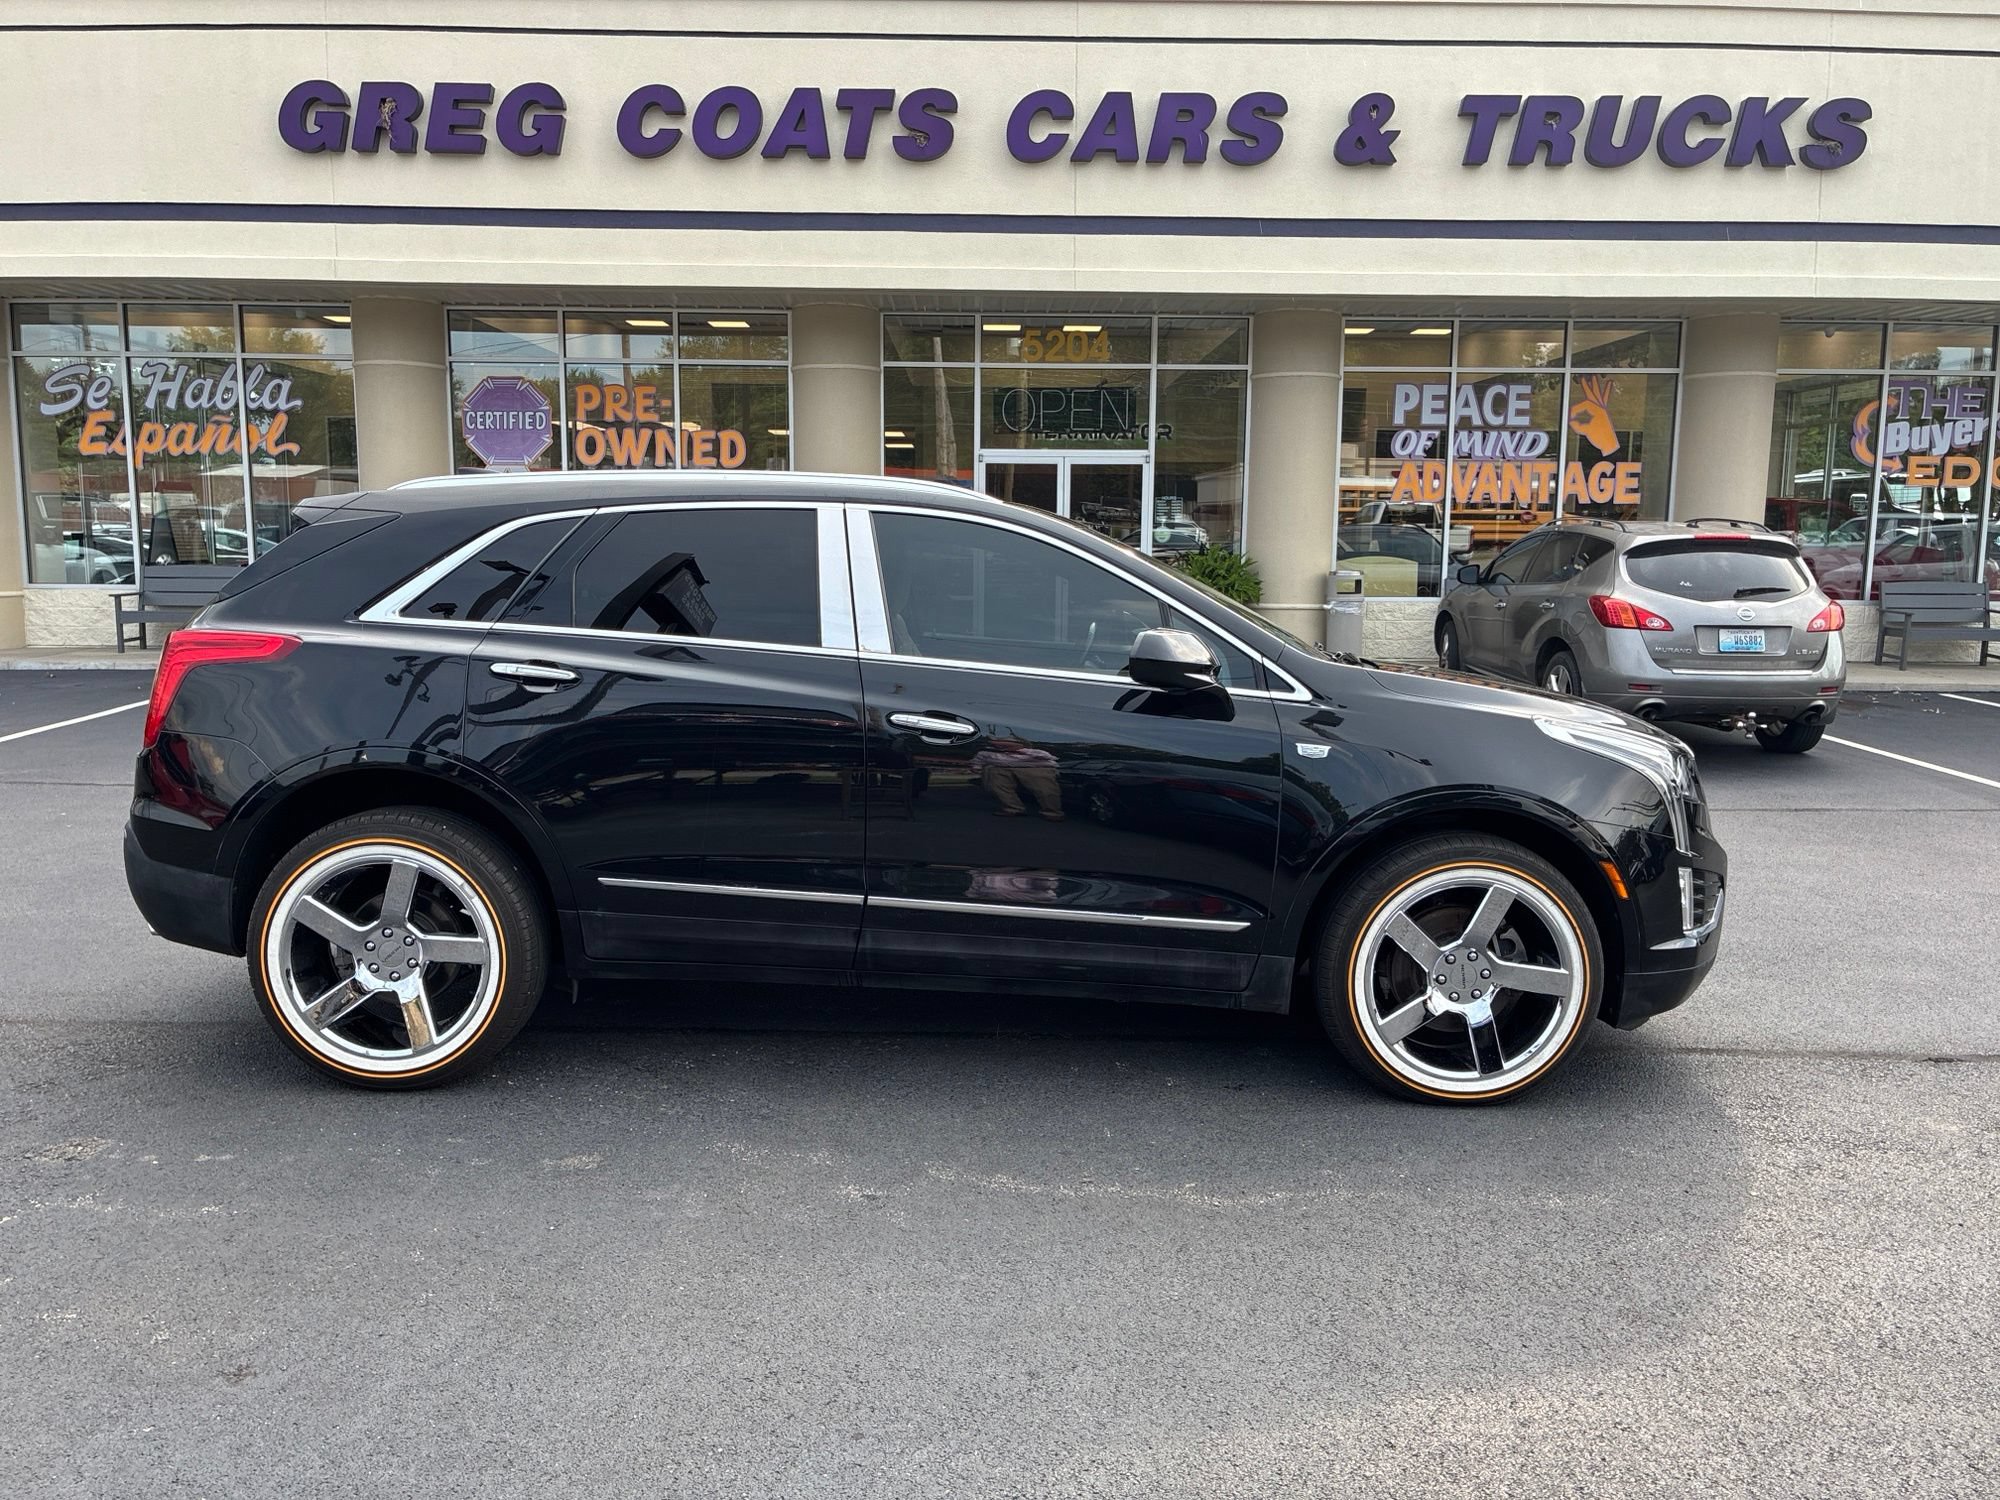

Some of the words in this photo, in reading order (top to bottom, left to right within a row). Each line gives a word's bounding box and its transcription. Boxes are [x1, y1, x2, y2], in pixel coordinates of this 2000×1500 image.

[278, 79, 567, 158] GREG
[616, 83, 959, 163] COATS
[1005, 88, 1290, 166] CARS
[1334, 92, 1401, 169] &
[1458, 94, 1874, 171] TRUCKS
[1023, 328, 1111, 362] 5204
[40, 363, 113, 416] Se
[141, 361, 303, 411] Habla
[575, 383, 673, 423] PRE-
[1392, 384, 1533, 426] PEACE
[1887, 380, 1987, 420] THE
[465, 411, 547, 430] CERTIFIED
[1002, 388, 1130, 432] OPEN
[78, 409, 301, 470] Español
[575, 427, 748, 468] OWNED
[1391, 429, 1440, 459] OF
[1452, 429, 1550, 460] MIND
[1884, 417, 2000, 458] Buyer
[1391, 461, 1642, 505] ADVANTAGE
[1655, 646, 1692, 654] MURANO
[1734, 635, 1763, 646] W6S882
